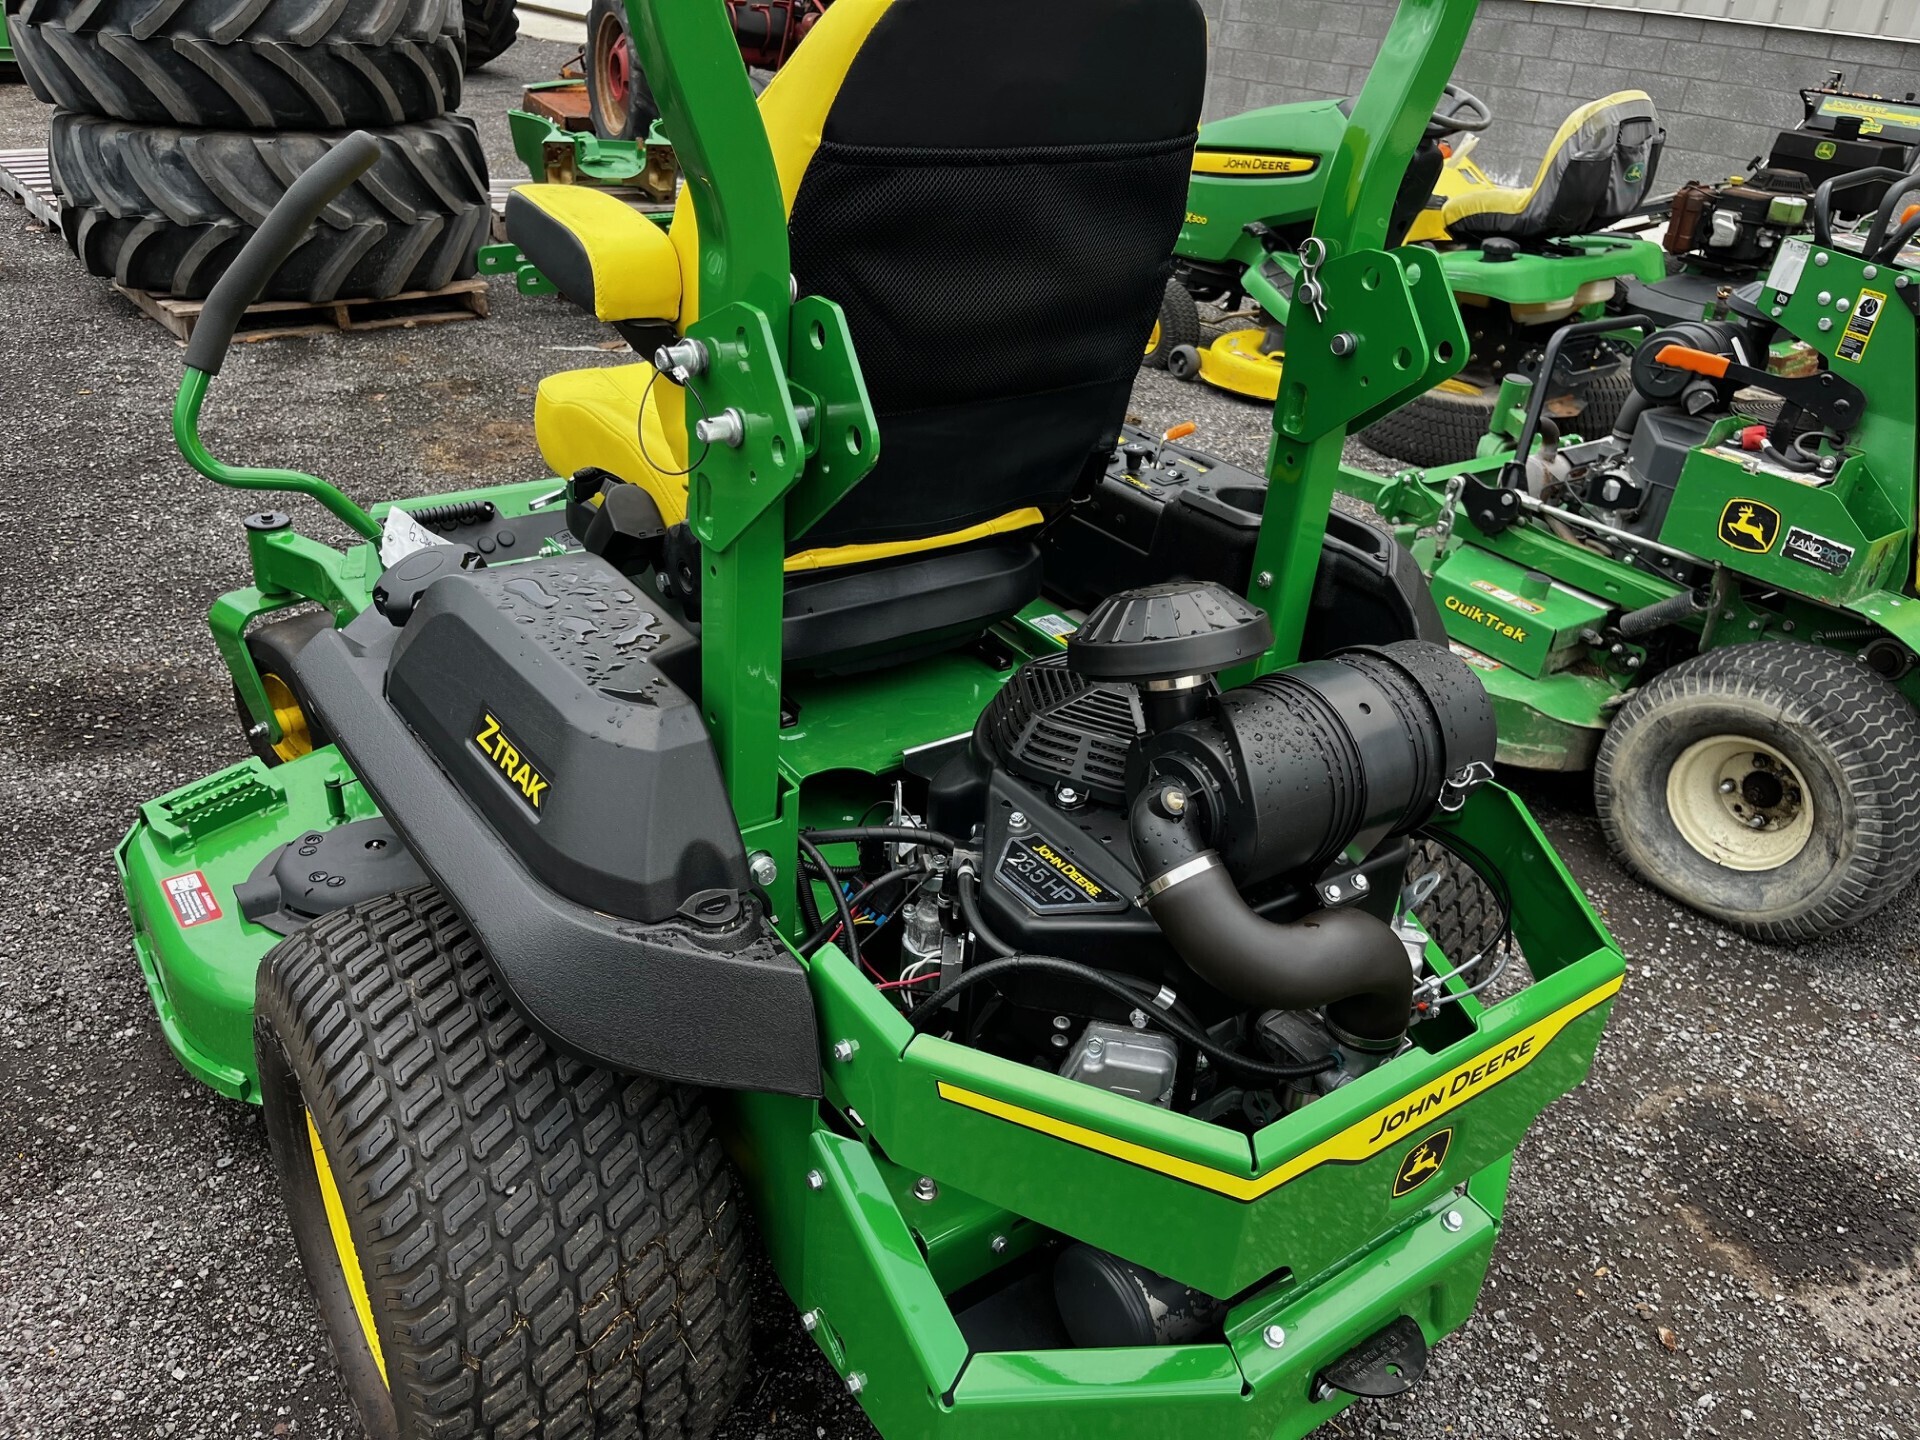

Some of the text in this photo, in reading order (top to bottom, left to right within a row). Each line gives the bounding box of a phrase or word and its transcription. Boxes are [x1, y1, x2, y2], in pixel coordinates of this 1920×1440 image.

[1224, 158, 1291, 171] JOHN DEERE
[1185, 212, 1207, 225] X300
[1789, 535, 1848, 565] LANDPRO
[1445, 596, 1526, 643] QuikTrak
[476, 713, 548, 808] ZTRAK
[1006, 851, 1051, 883] 23.5
[1041, 878, 1076, 902] HP
[1032, 844, 1066, 869] JOHN
[1061, 864, 1102, 897] DEERE
[1368, 1035, 1536, 1144] JOHN DEERE
